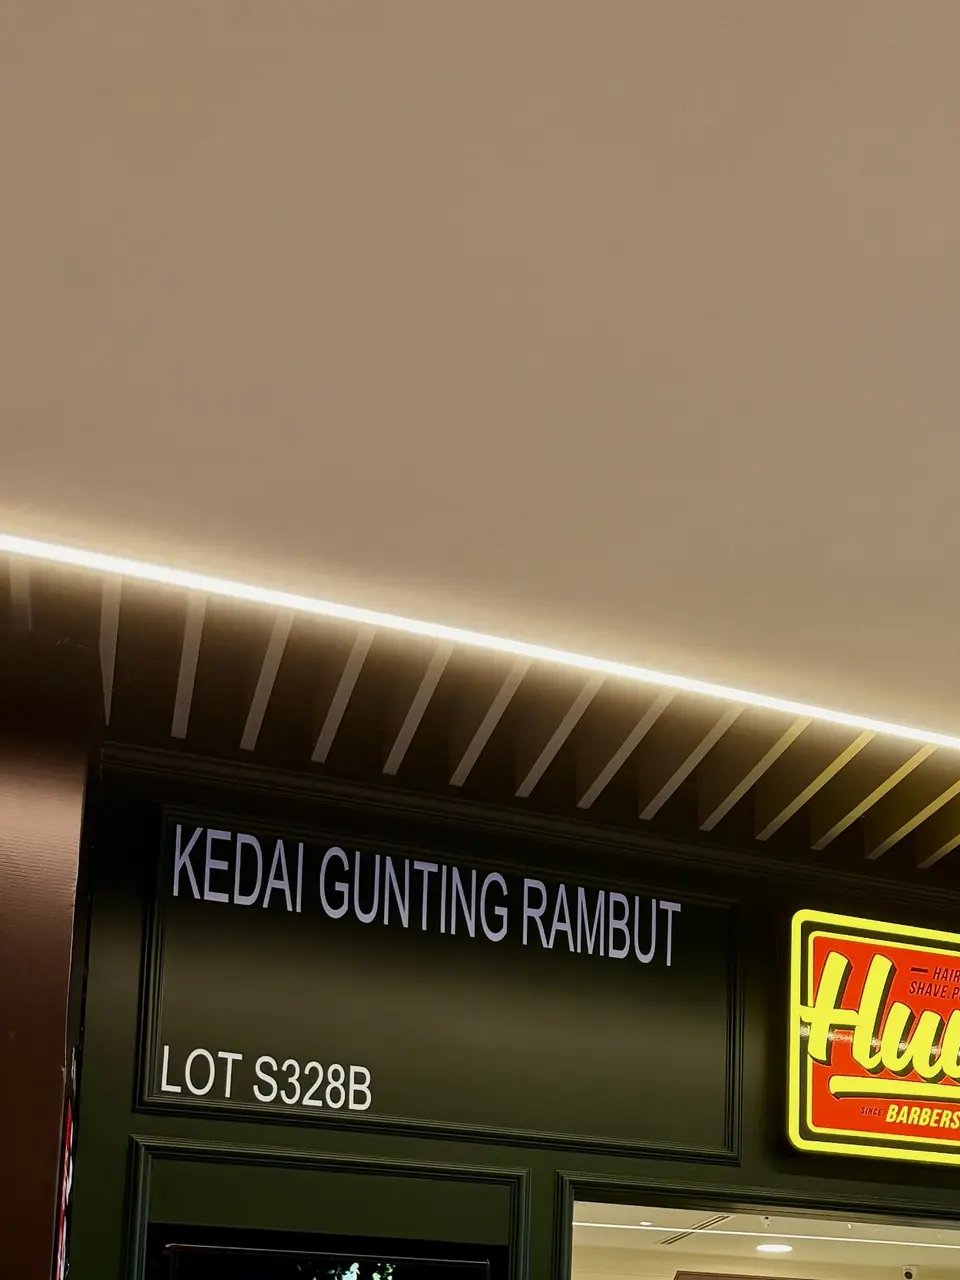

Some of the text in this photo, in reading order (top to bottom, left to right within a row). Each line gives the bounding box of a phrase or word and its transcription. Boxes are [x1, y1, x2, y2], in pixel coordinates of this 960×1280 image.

[172, 824, 682, 967] KEDAI GUNTING RAMBUT
[160, 1045, 372, 1111] LOT S328B
[860, 1106, 882, 1117] SINCE
